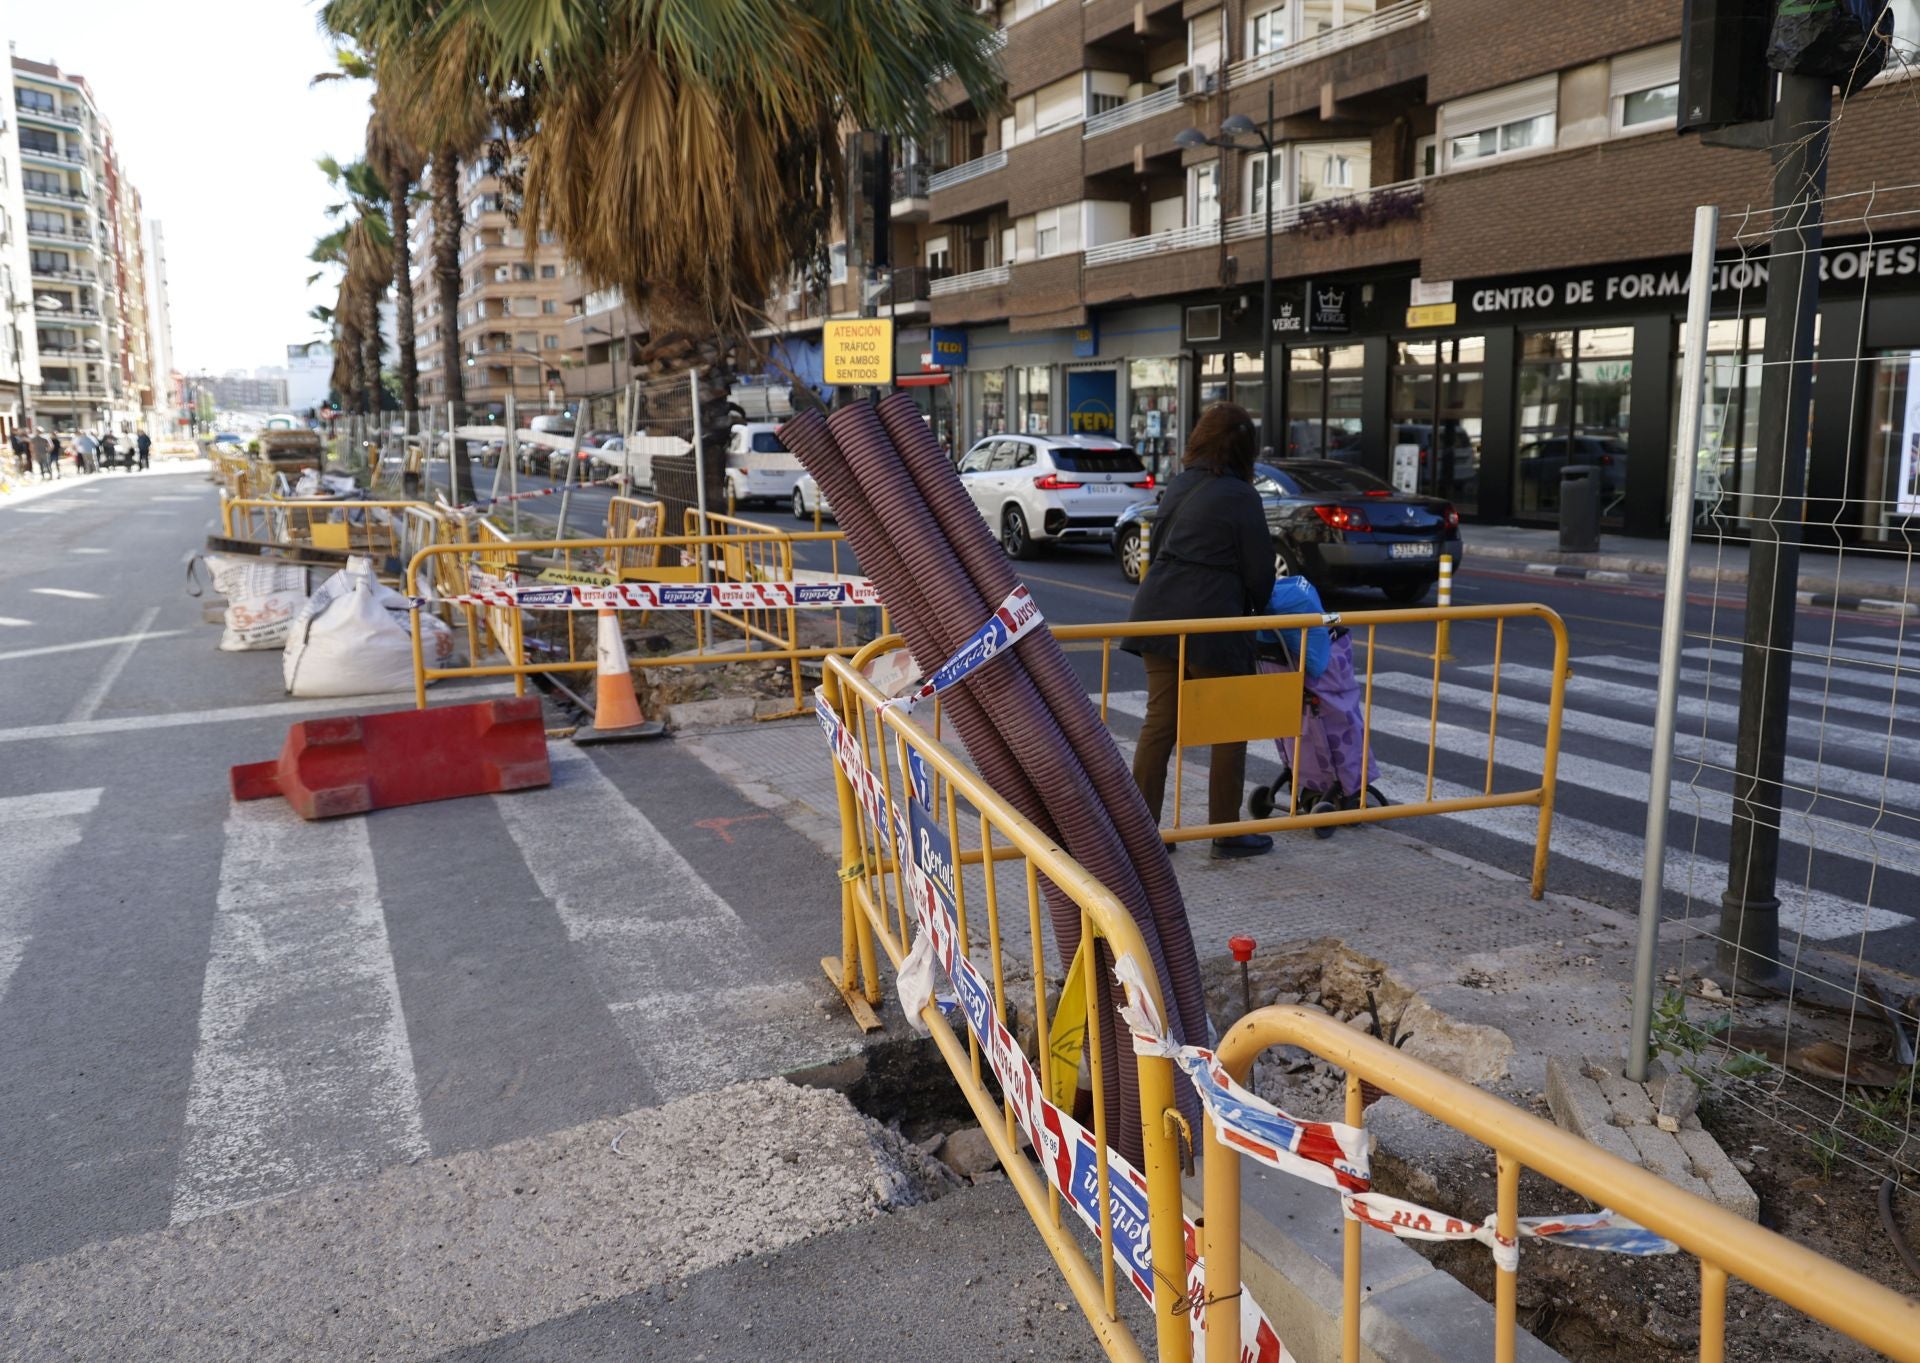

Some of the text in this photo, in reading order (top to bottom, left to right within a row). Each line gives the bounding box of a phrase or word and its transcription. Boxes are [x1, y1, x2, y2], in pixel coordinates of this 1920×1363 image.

[1472, 284, 1555, 313] CENTRO
[1565, 280, 1594, 305] DE
[1272, 317, 1301, 331] VERGE
[1315, 312, 1346, 324] VERGE
[834, 325, 881, 338] ATENCIÓN
[840, 341, 876, 352] TRÁFICO
[835, 355, 880, 365] EN AMBOS
[836, 369, 878, 379] SENTIDOS
[721, 591, 755, 600] NO PASAR
[1013, 599, 1039, 627] ASAR
[1014, 1071, 1024, 1105] NO
